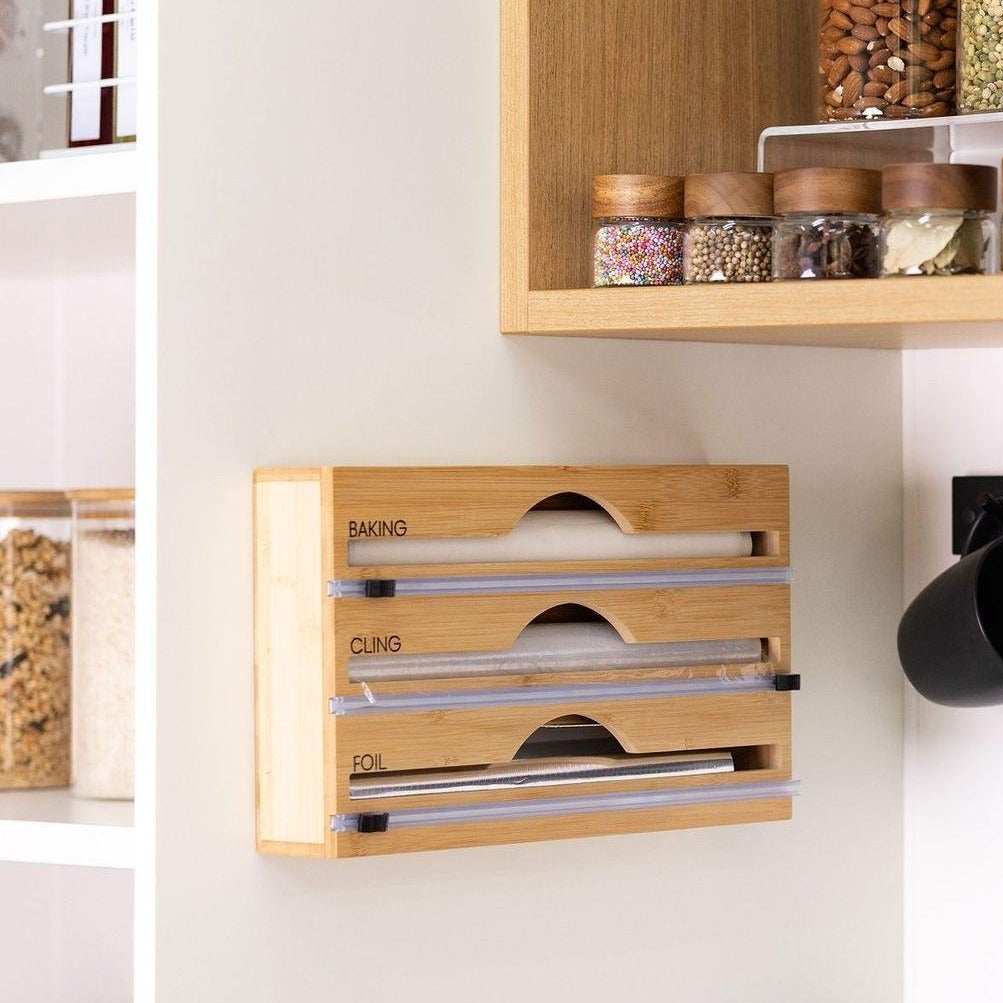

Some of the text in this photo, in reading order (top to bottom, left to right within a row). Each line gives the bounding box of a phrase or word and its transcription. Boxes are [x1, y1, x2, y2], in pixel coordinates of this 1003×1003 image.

[349, 520, 407, 537] BAKING
[350, 635, 401, 654] CLING
[353, 753, 387, 772] FOIL
